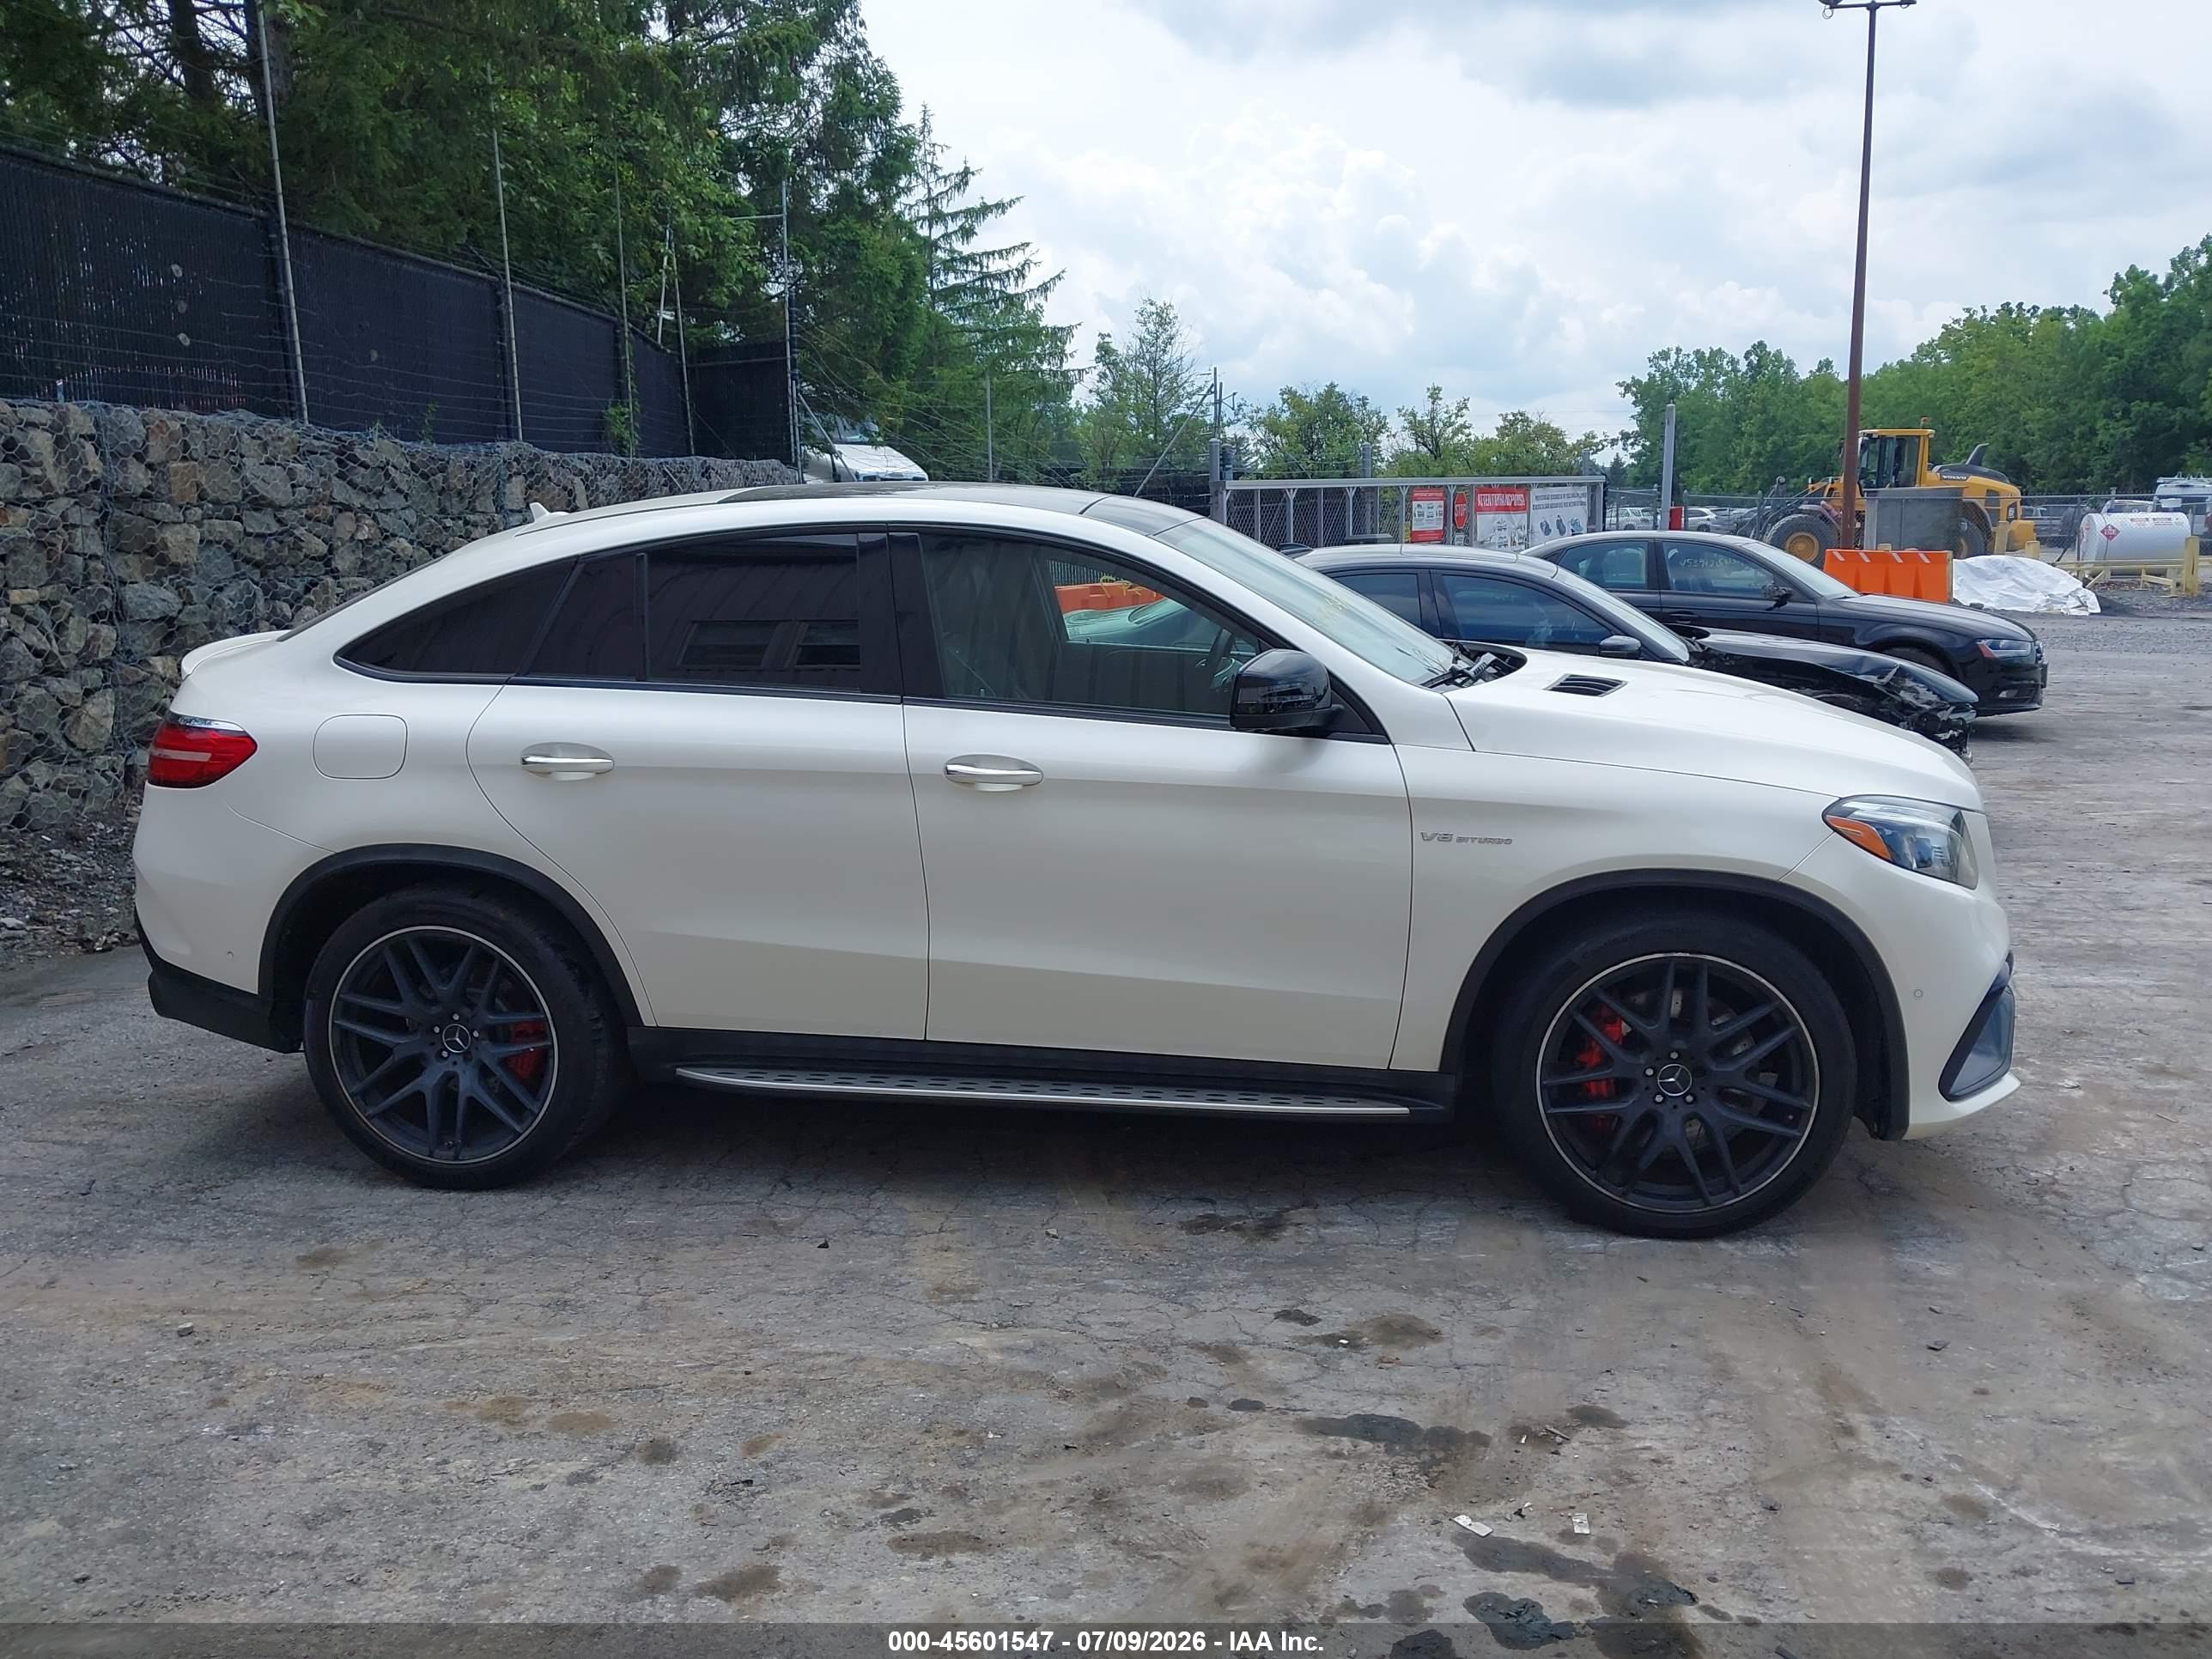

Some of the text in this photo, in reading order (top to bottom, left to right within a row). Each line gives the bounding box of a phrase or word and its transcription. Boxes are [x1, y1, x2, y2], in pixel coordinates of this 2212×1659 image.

[1455, 503, 1467, 517] STOP
[1420, 831, 1513, 845] V8 BITURBO
